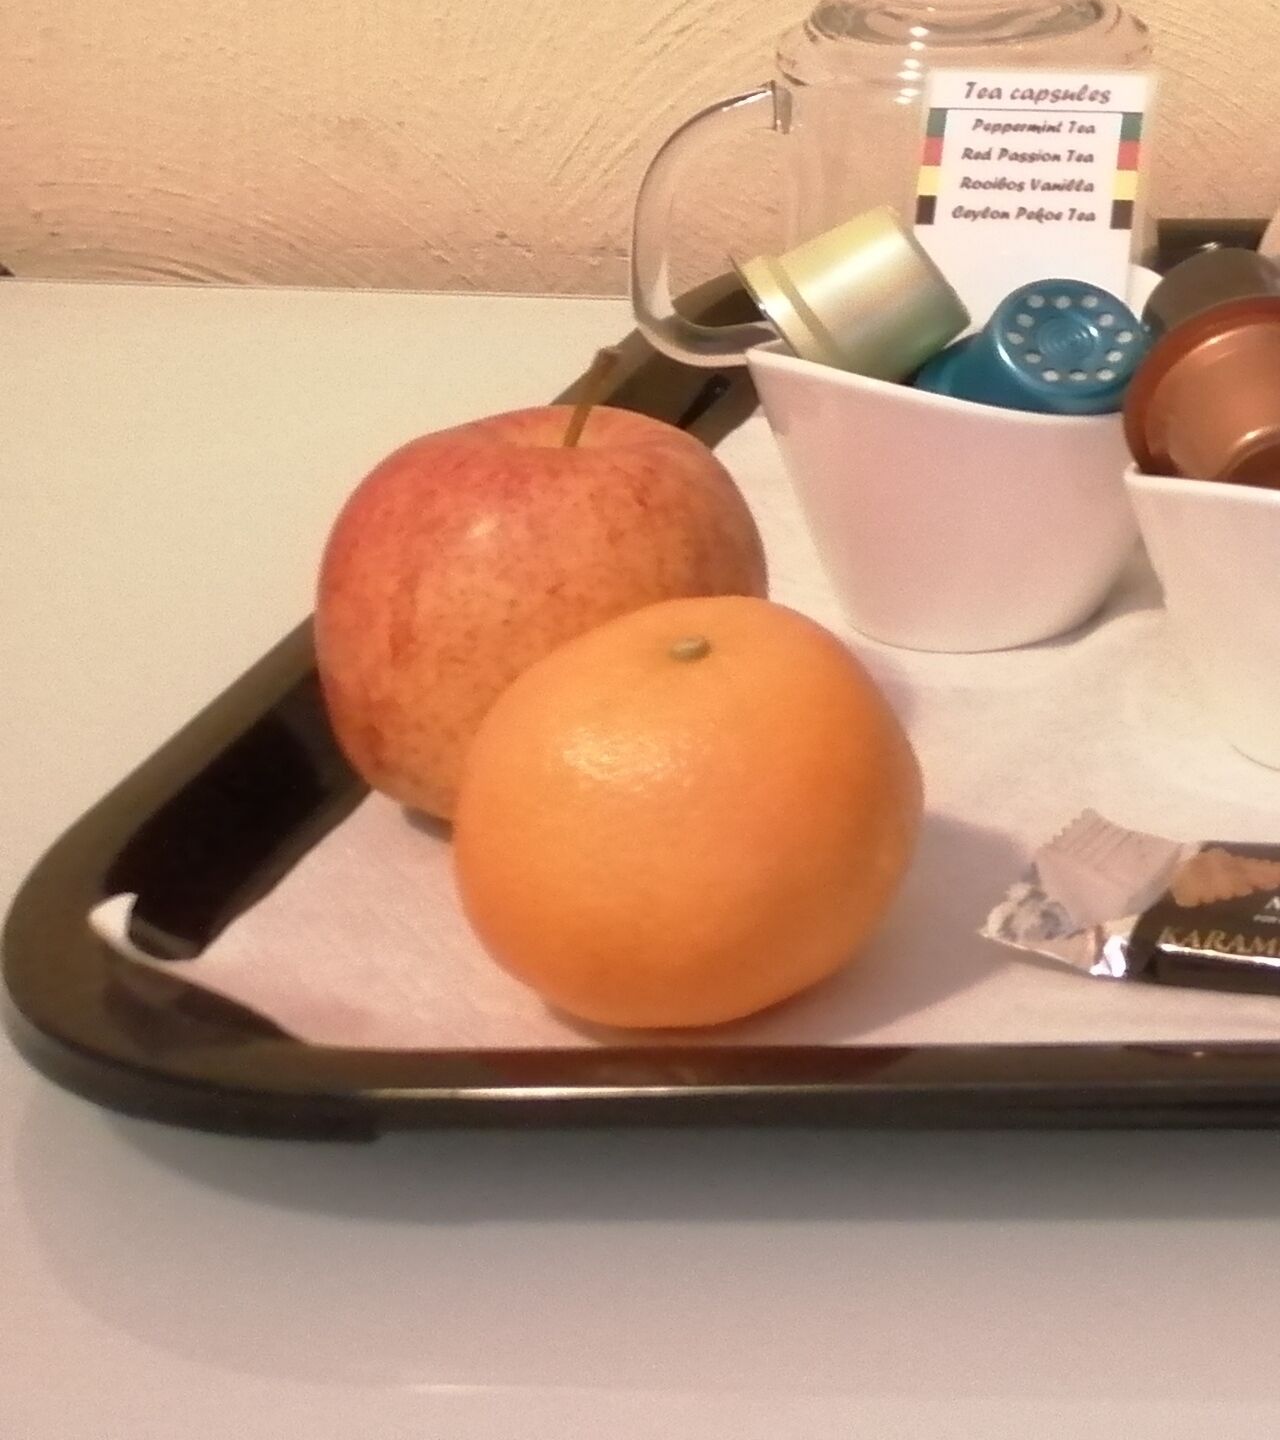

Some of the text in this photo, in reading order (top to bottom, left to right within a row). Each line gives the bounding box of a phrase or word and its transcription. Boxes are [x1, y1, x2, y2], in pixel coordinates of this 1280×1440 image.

[964, 82, 1112, 105] Tea capsules
[971, 118, 1096, 135] Peppermint Tea
[961, 147, 1095, 164] Red Passion Tea
[959, 176, 1095, 193] Rooibos Vanilla
[951, 205, 1096, 224] Ceylon Pekoe Tea
